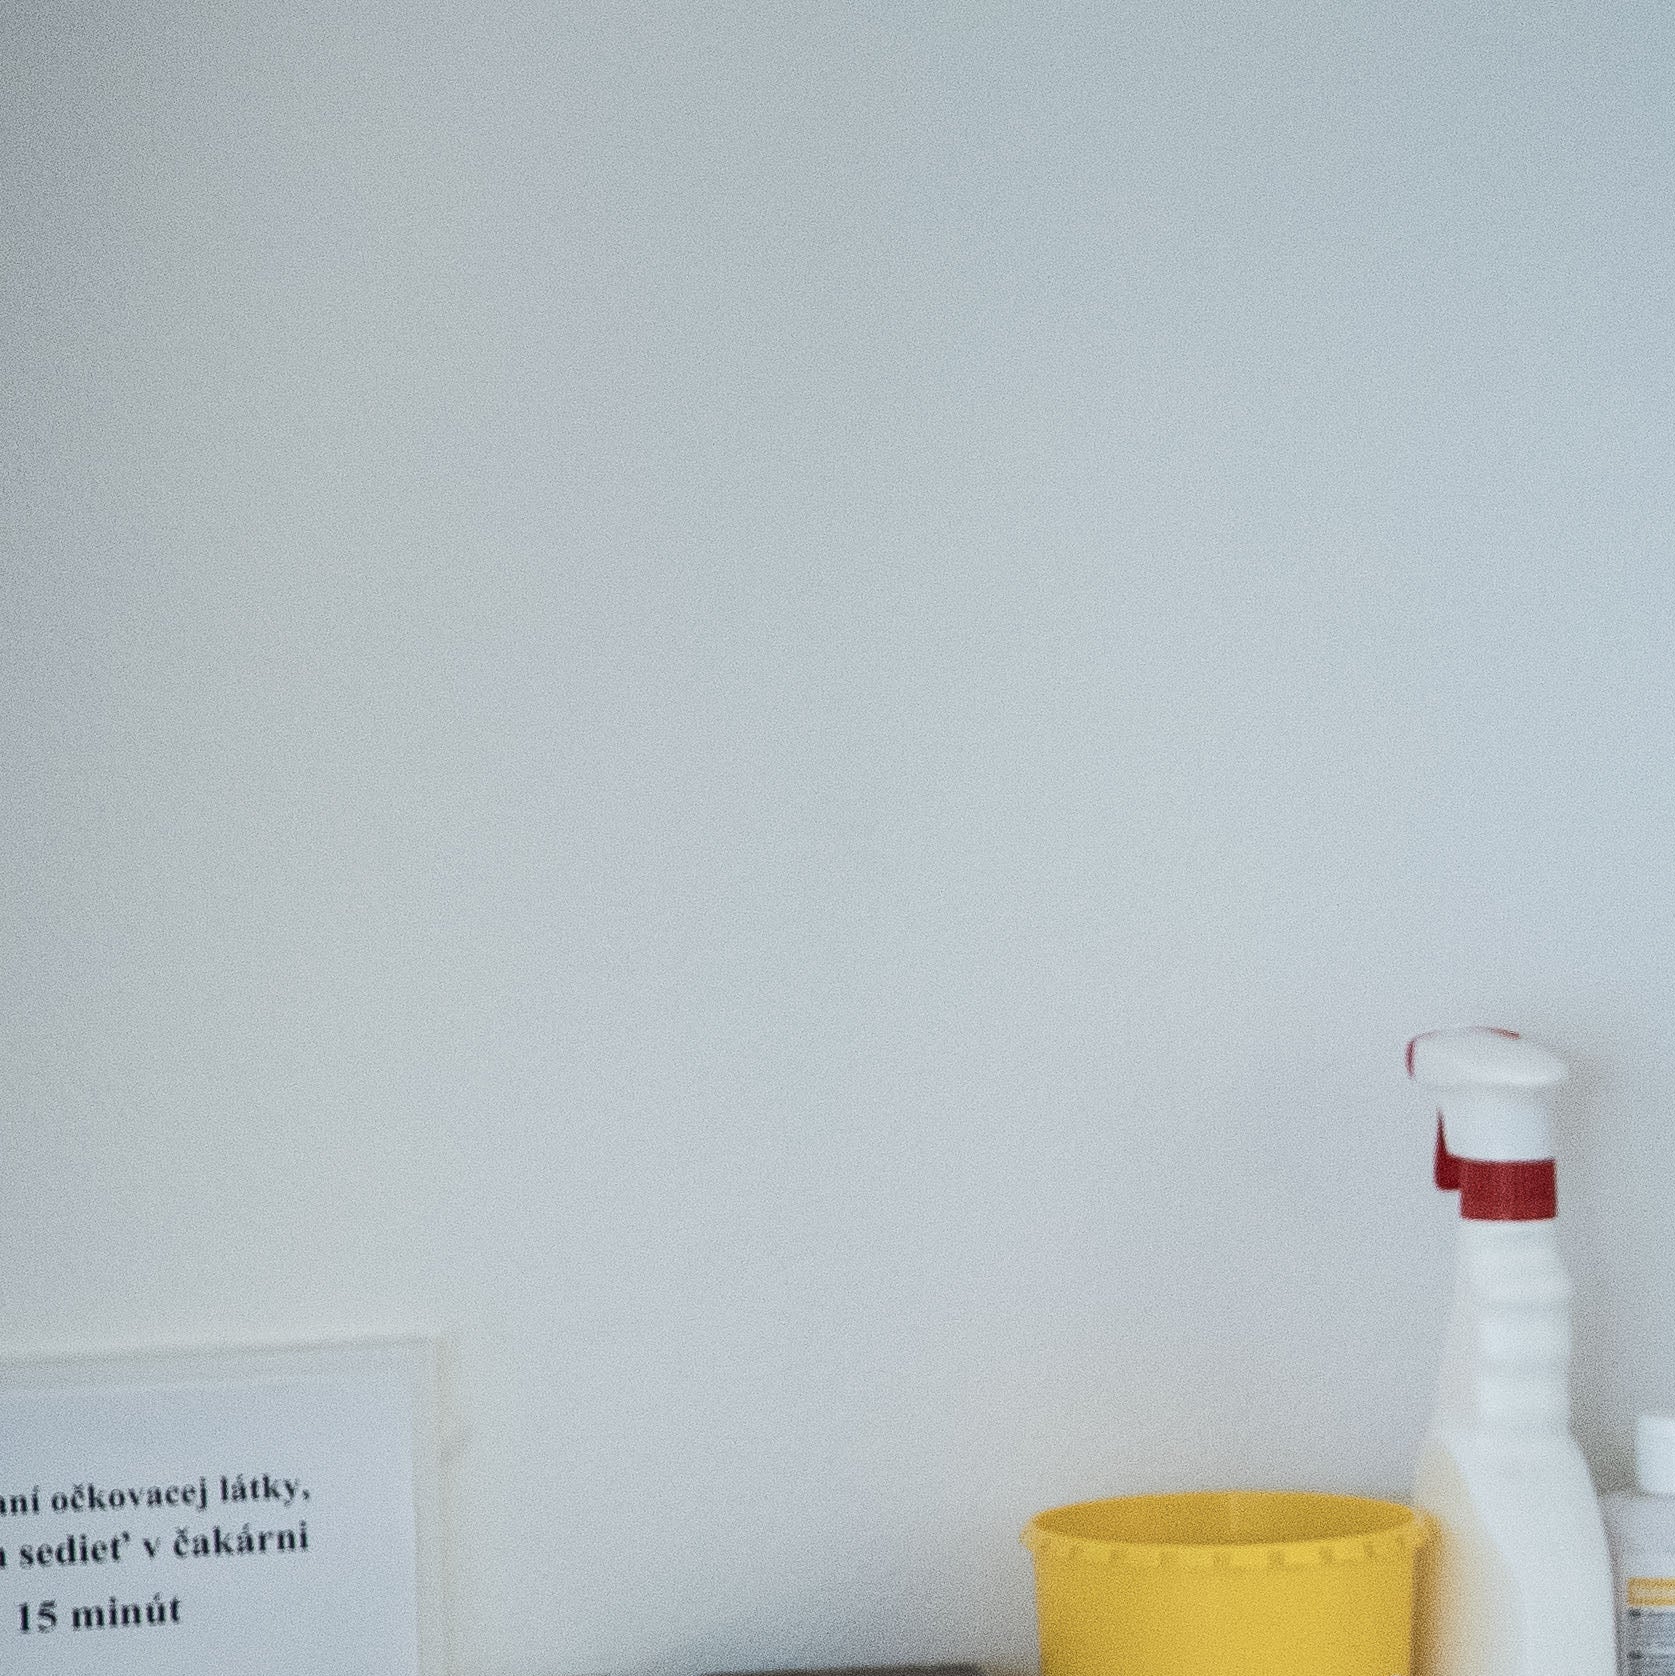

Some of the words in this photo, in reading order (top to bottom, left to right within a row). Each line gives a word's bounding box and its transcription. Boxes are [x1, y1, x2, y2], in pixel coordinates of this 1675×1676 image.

[51, 1476, 208, 1511] očkovacej
[220, 1472, 312, 1506] látky,
[19, 1530, 130, 1569] sedieť
[143, 1536, 161, 1560] v
[173, 1521, 309, 1559] čakárni
[18, 1600, 58, 1634] 15
[71, 1592, 182, 1631] minút
